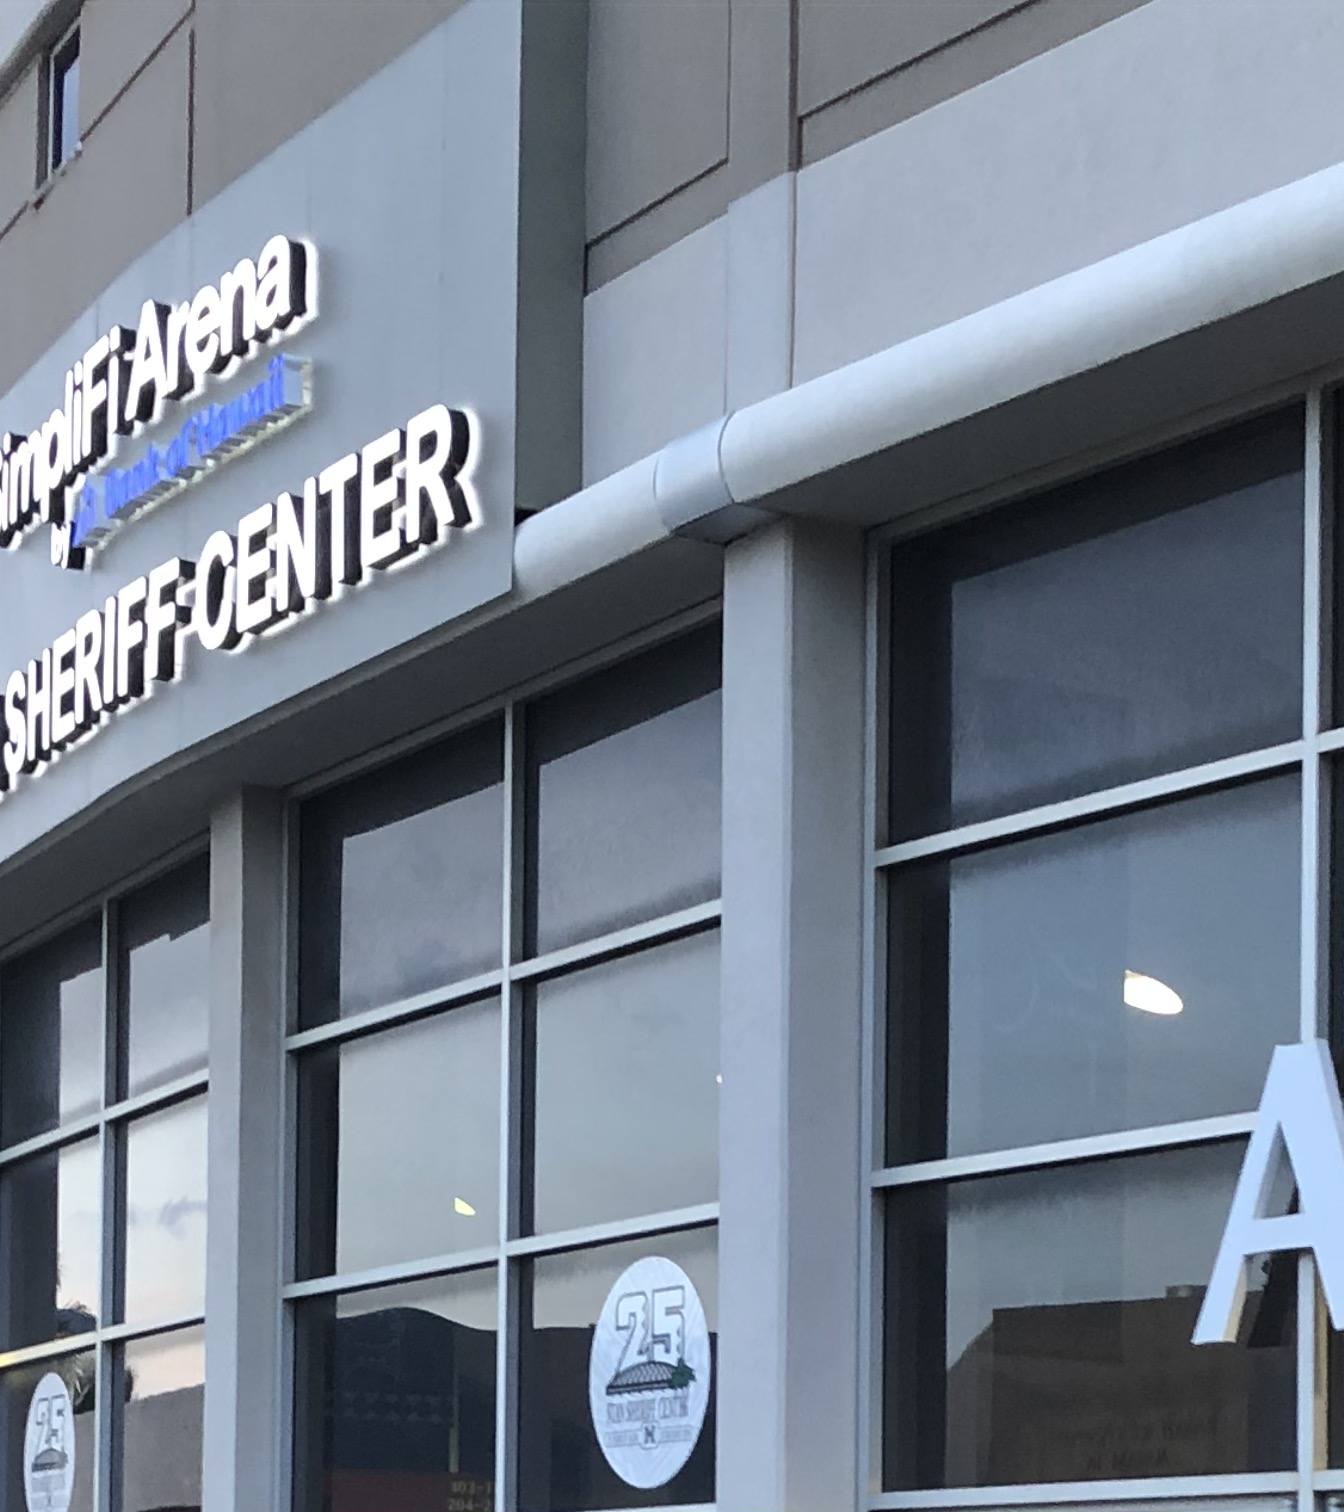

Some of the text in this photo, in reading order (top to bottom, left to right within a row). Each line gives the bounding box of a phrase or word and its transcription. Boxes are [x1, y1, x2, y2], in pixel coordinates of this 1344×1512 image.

[124, 235, 293, 423] Arena
[4, 557, 180, 776] SHERIFF
[192, 403, 455, 650] CENTER
[612, 1286, 686, 1378] 25
